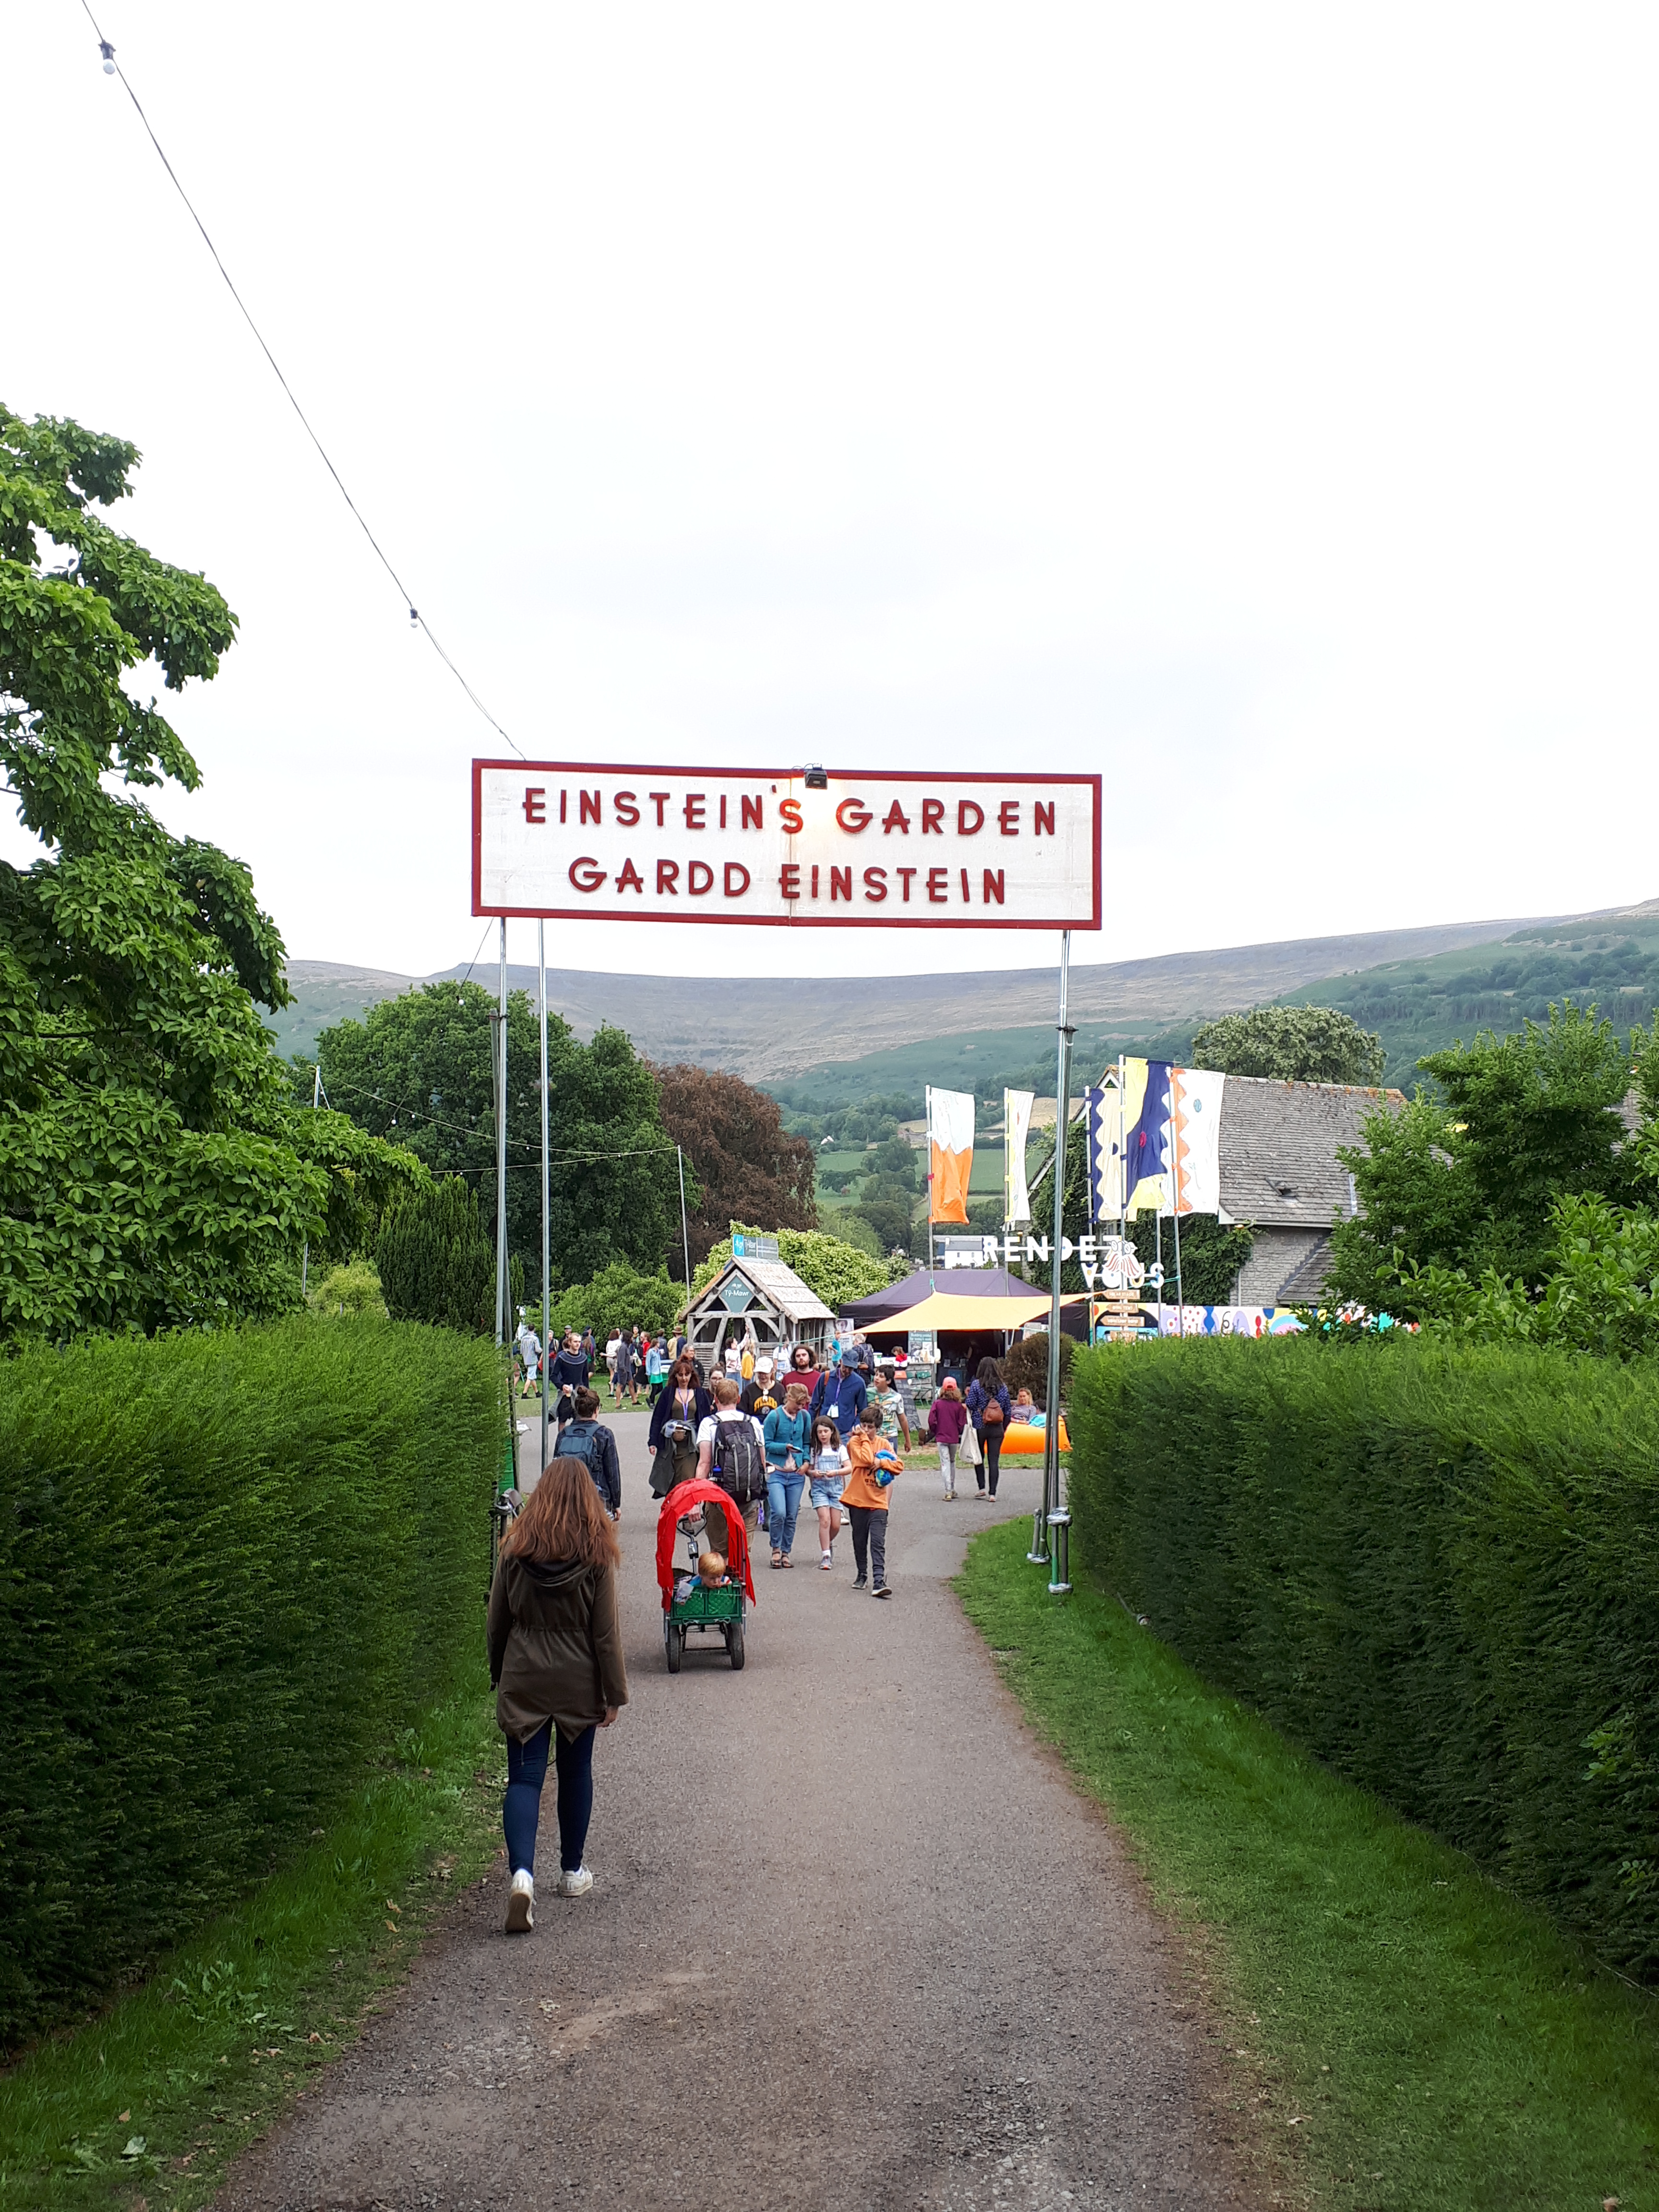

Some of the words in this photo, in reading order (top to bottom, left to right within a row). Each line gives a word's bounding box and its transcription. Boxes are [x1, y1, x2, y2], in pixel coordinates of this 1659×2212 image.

[522, 784, 804, 834] EINSTEIN'S
[836, 797, 1055, 835] GARDEN
[568, 856, 750, 897] GARDD
[778, 864, 1005, 904] EINSTEIN
